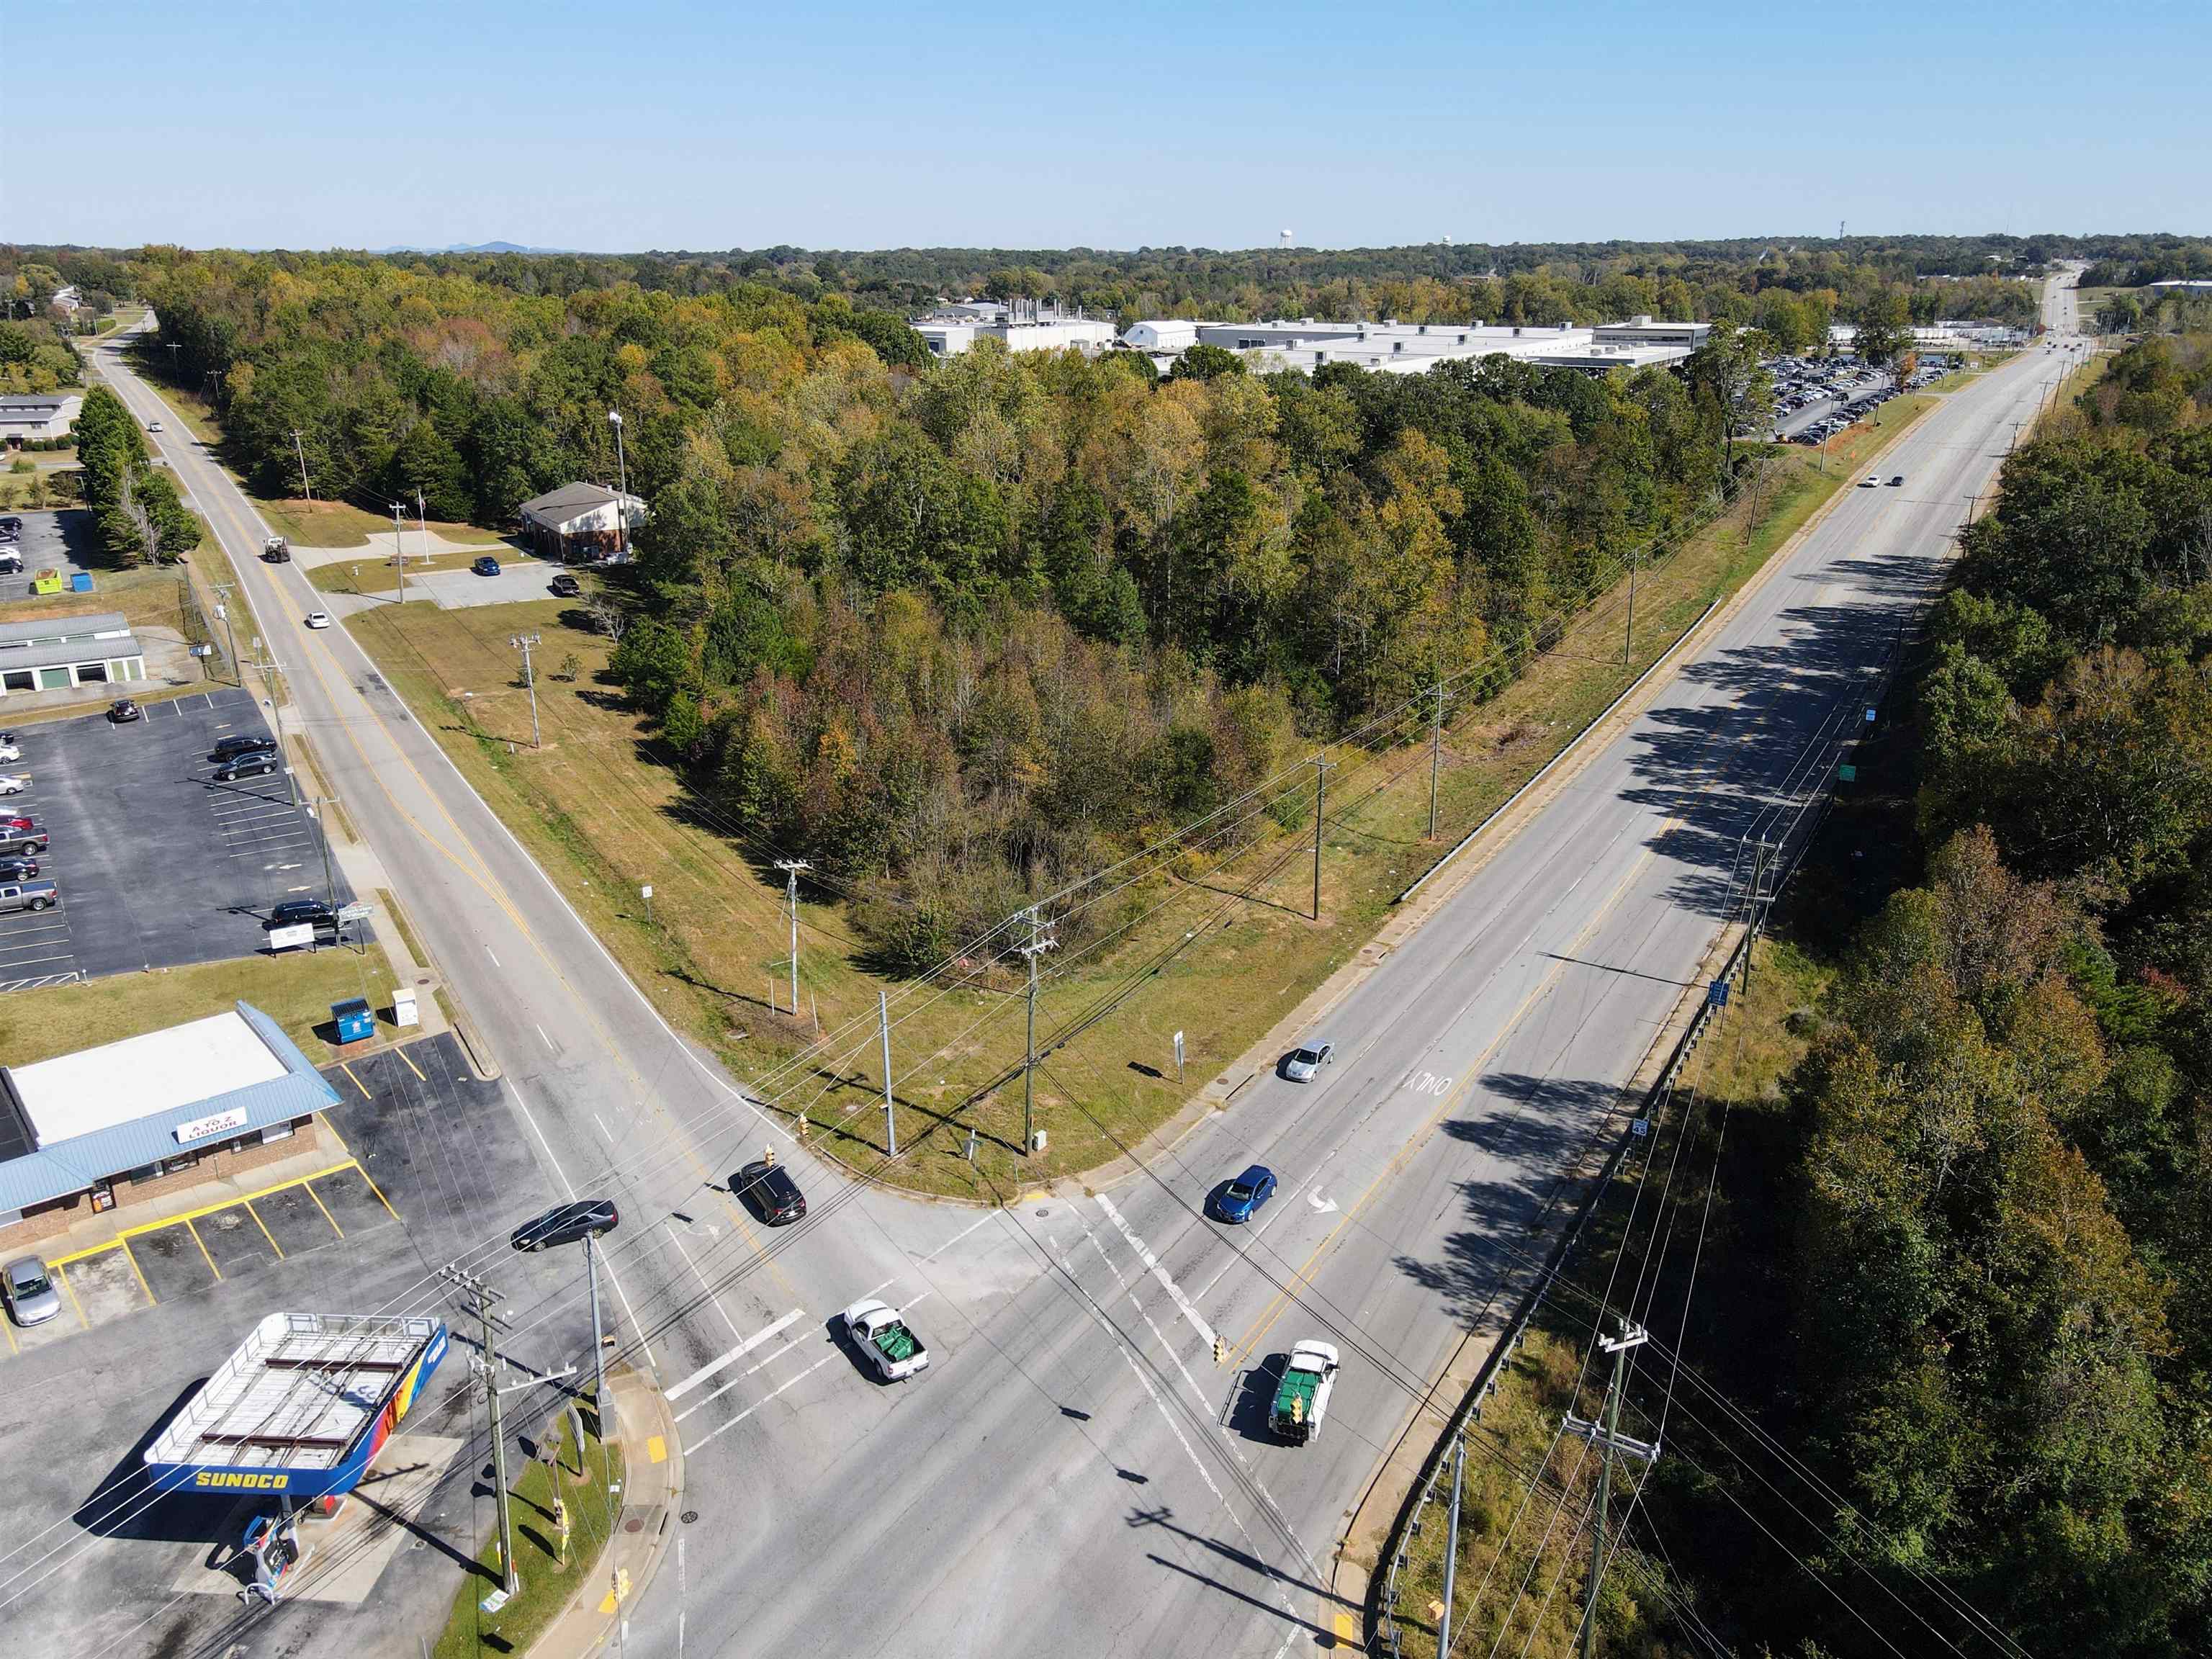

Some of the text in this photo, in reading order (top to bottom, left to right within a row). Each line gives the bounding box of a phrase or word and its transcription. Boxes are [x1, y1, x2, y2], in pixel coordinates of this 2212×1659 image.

[1402, 1070, 1452, 1096] ONLY
[189, 1120, 238, 1139] LIQUOR
[204, 1119, 220, 1128] TO
[195, 1472, 289, 1489] SUNOCO
